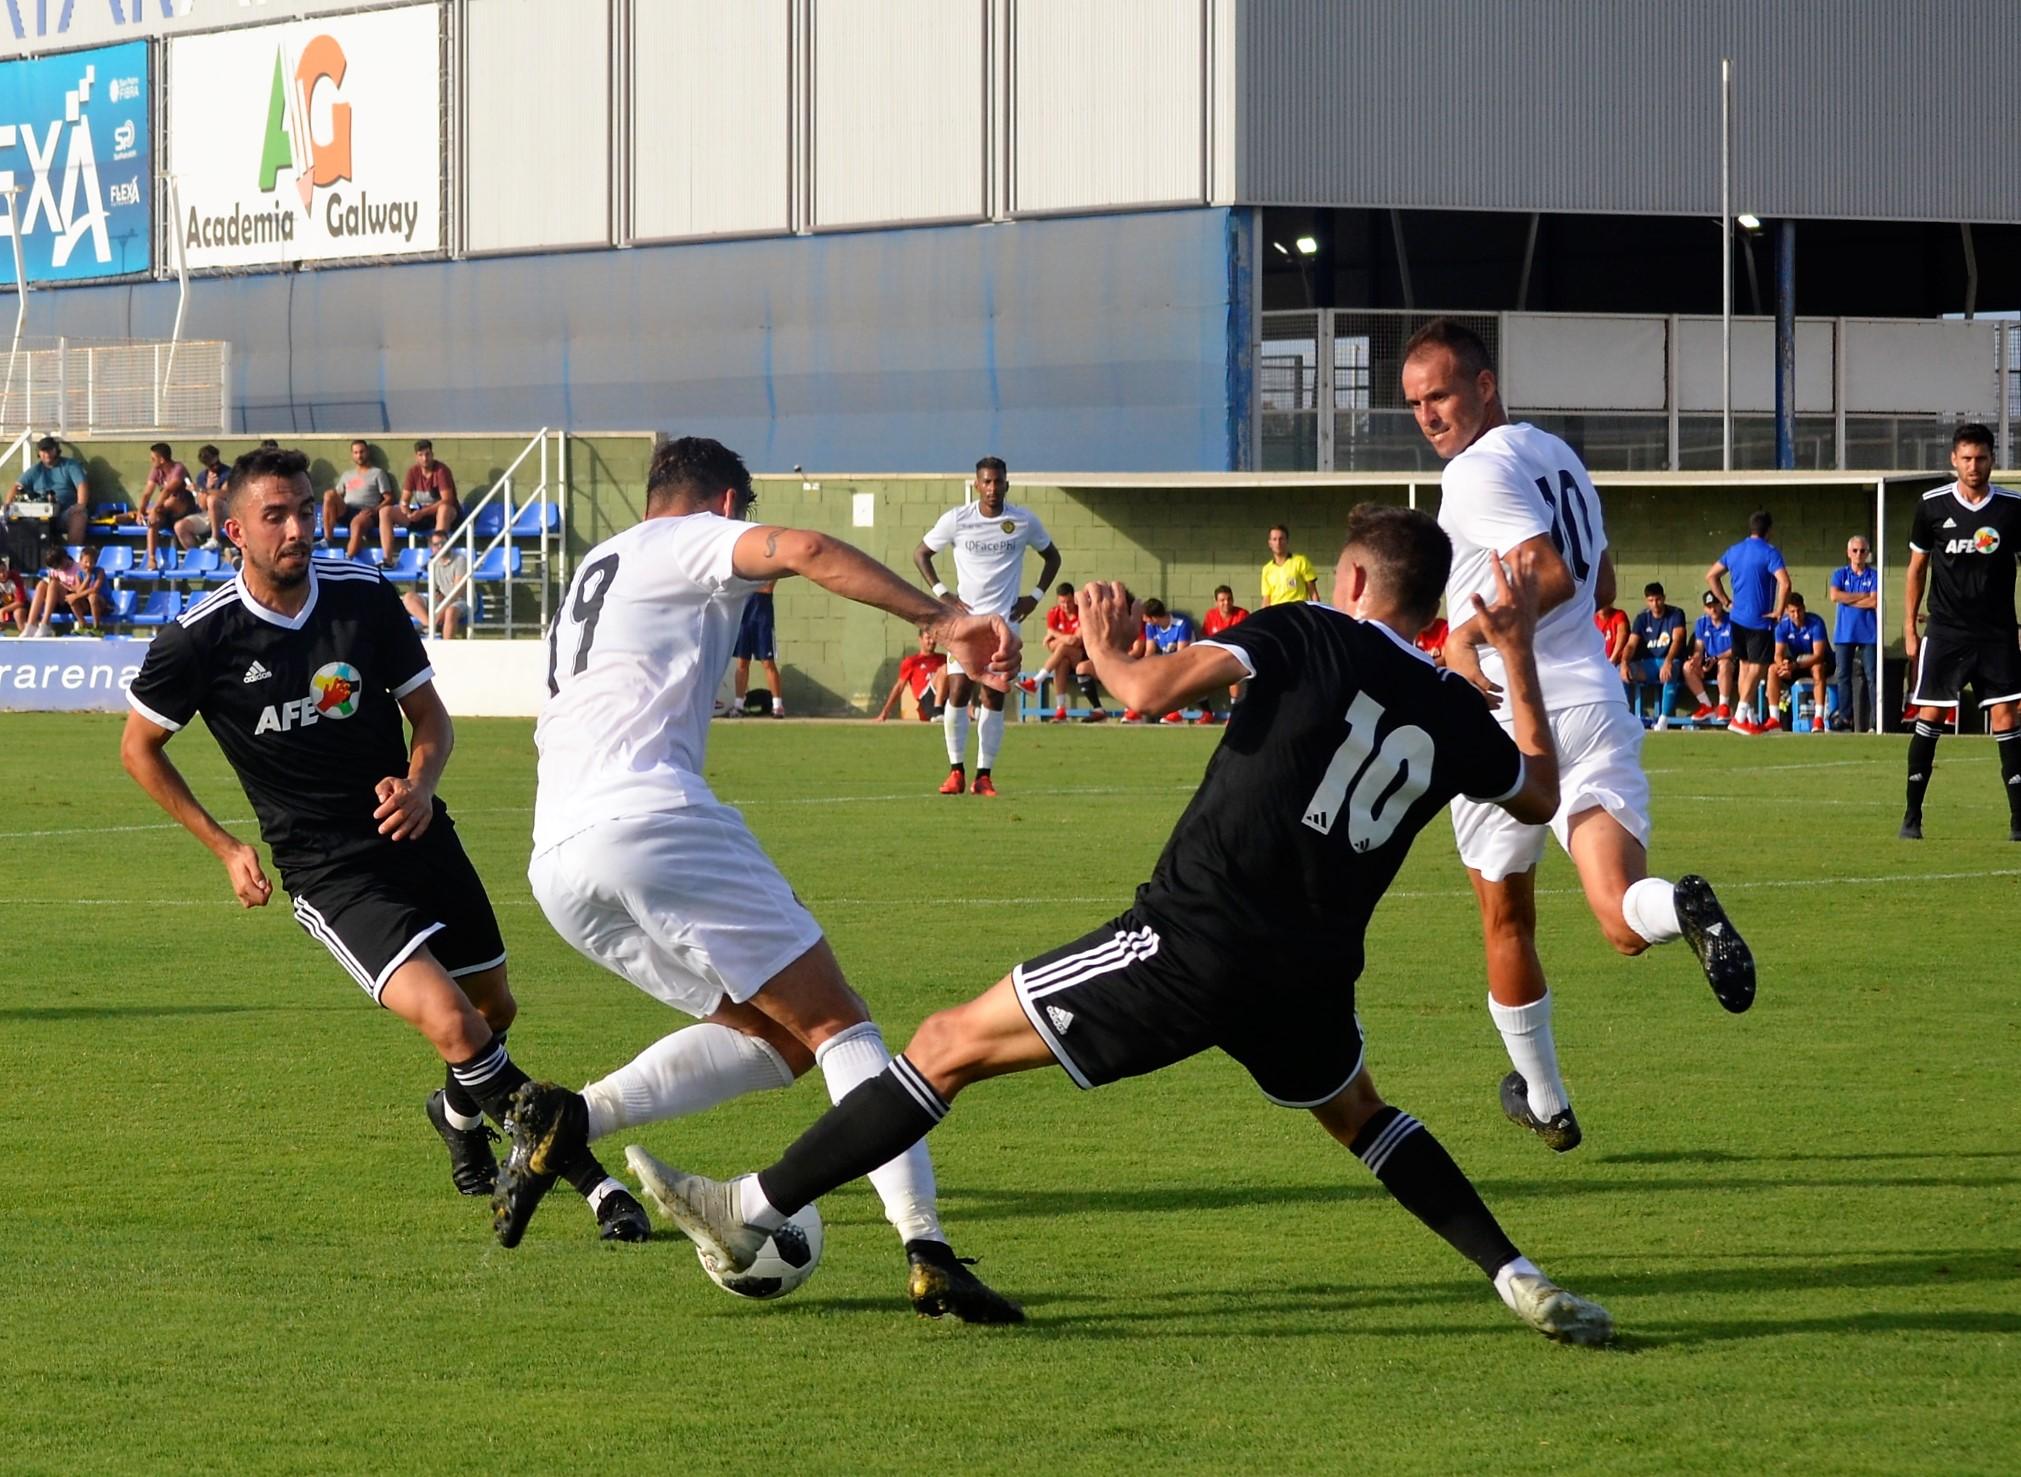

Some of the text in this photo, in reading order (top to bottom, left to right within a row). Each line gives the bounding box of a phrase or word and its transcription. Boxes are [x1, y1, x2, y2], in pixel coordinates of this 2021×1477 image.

[186, 191, 418, 249] Academia Galway
[1534, 469, 1592, 583] 10
[547, 552, 620, 699] 19
[243, 671, 272, 684] adidas
[254, 697, 320, 736] AFE
[1301, 689, 1435, 854] 10
